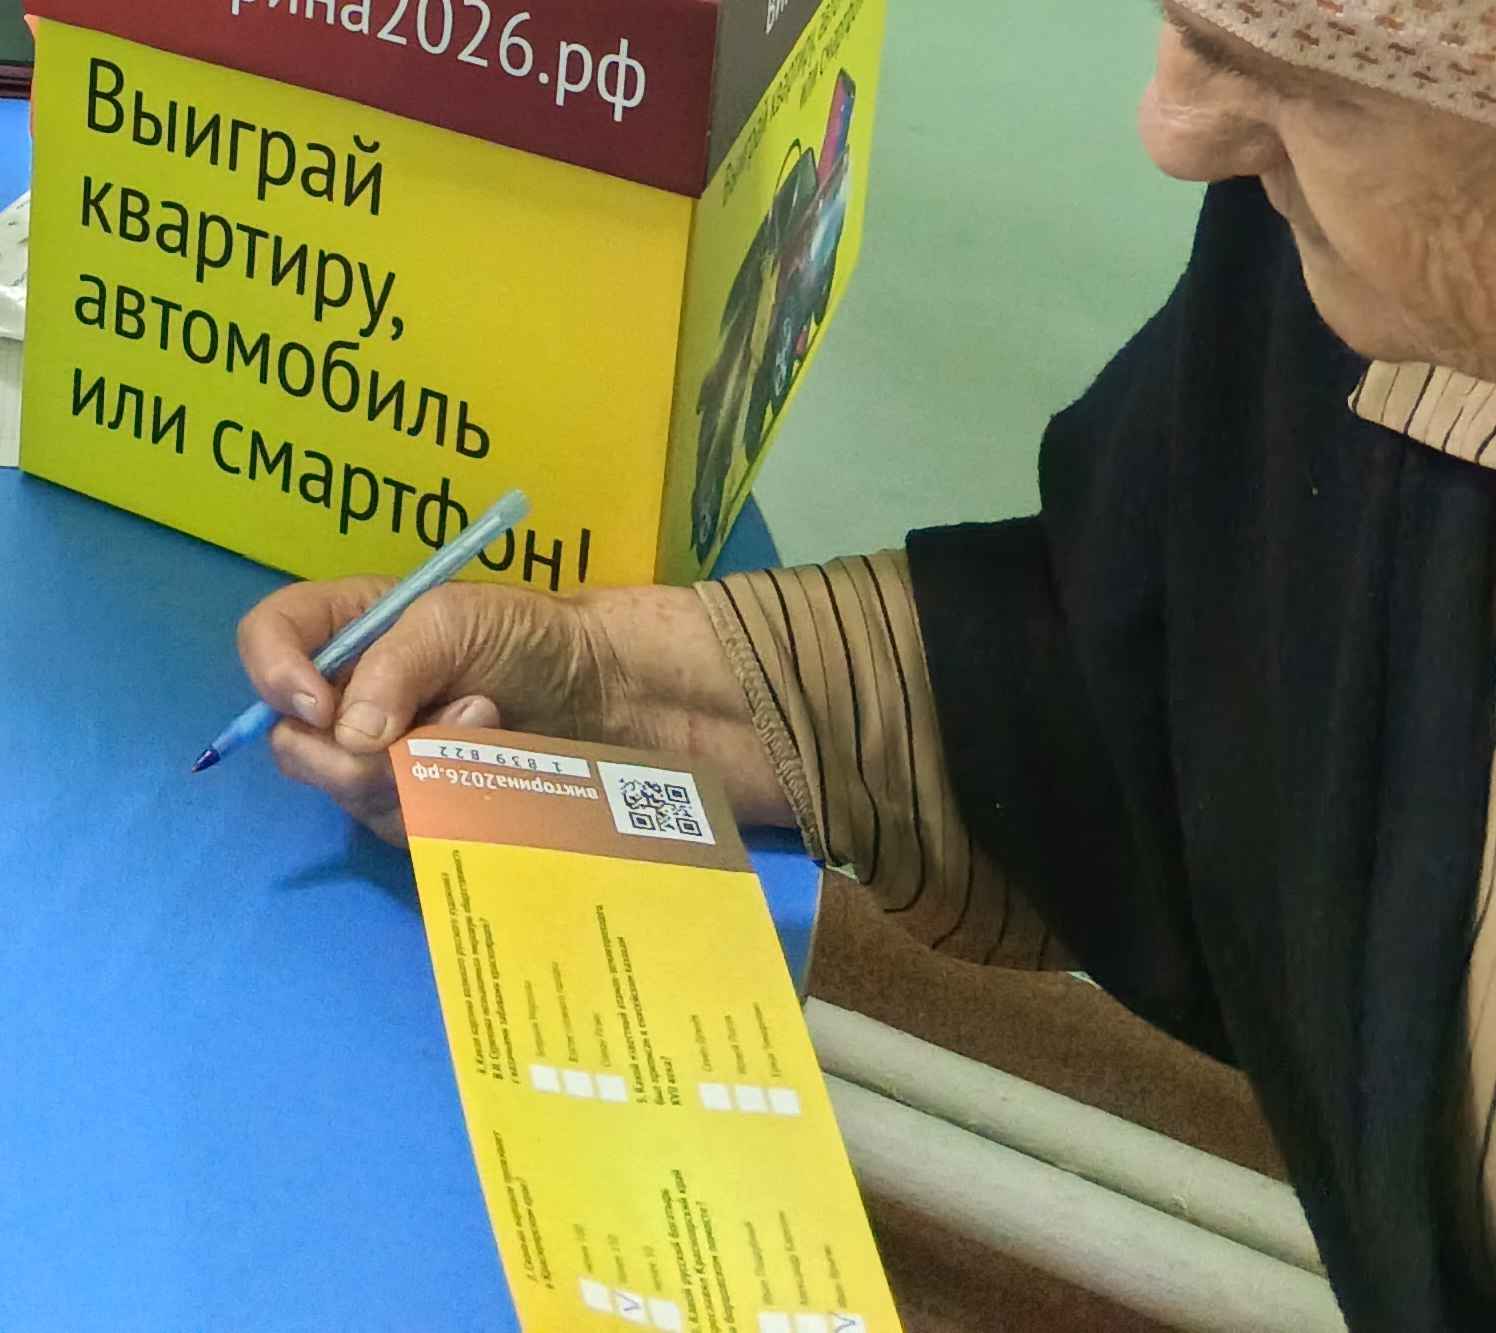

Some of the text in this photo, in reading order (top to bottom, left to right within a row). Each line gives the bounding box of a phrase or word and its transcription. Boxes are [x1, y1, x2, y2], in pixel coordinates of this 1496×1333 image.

[86, 56, 385, 217] Выиграй
[80, 175, 405, 341] квартиру,
[72, 367, 186, 455] или
[74, 271, 492, 461] автомобиль
[411, 760, 599, 800] викторина2026.рф
